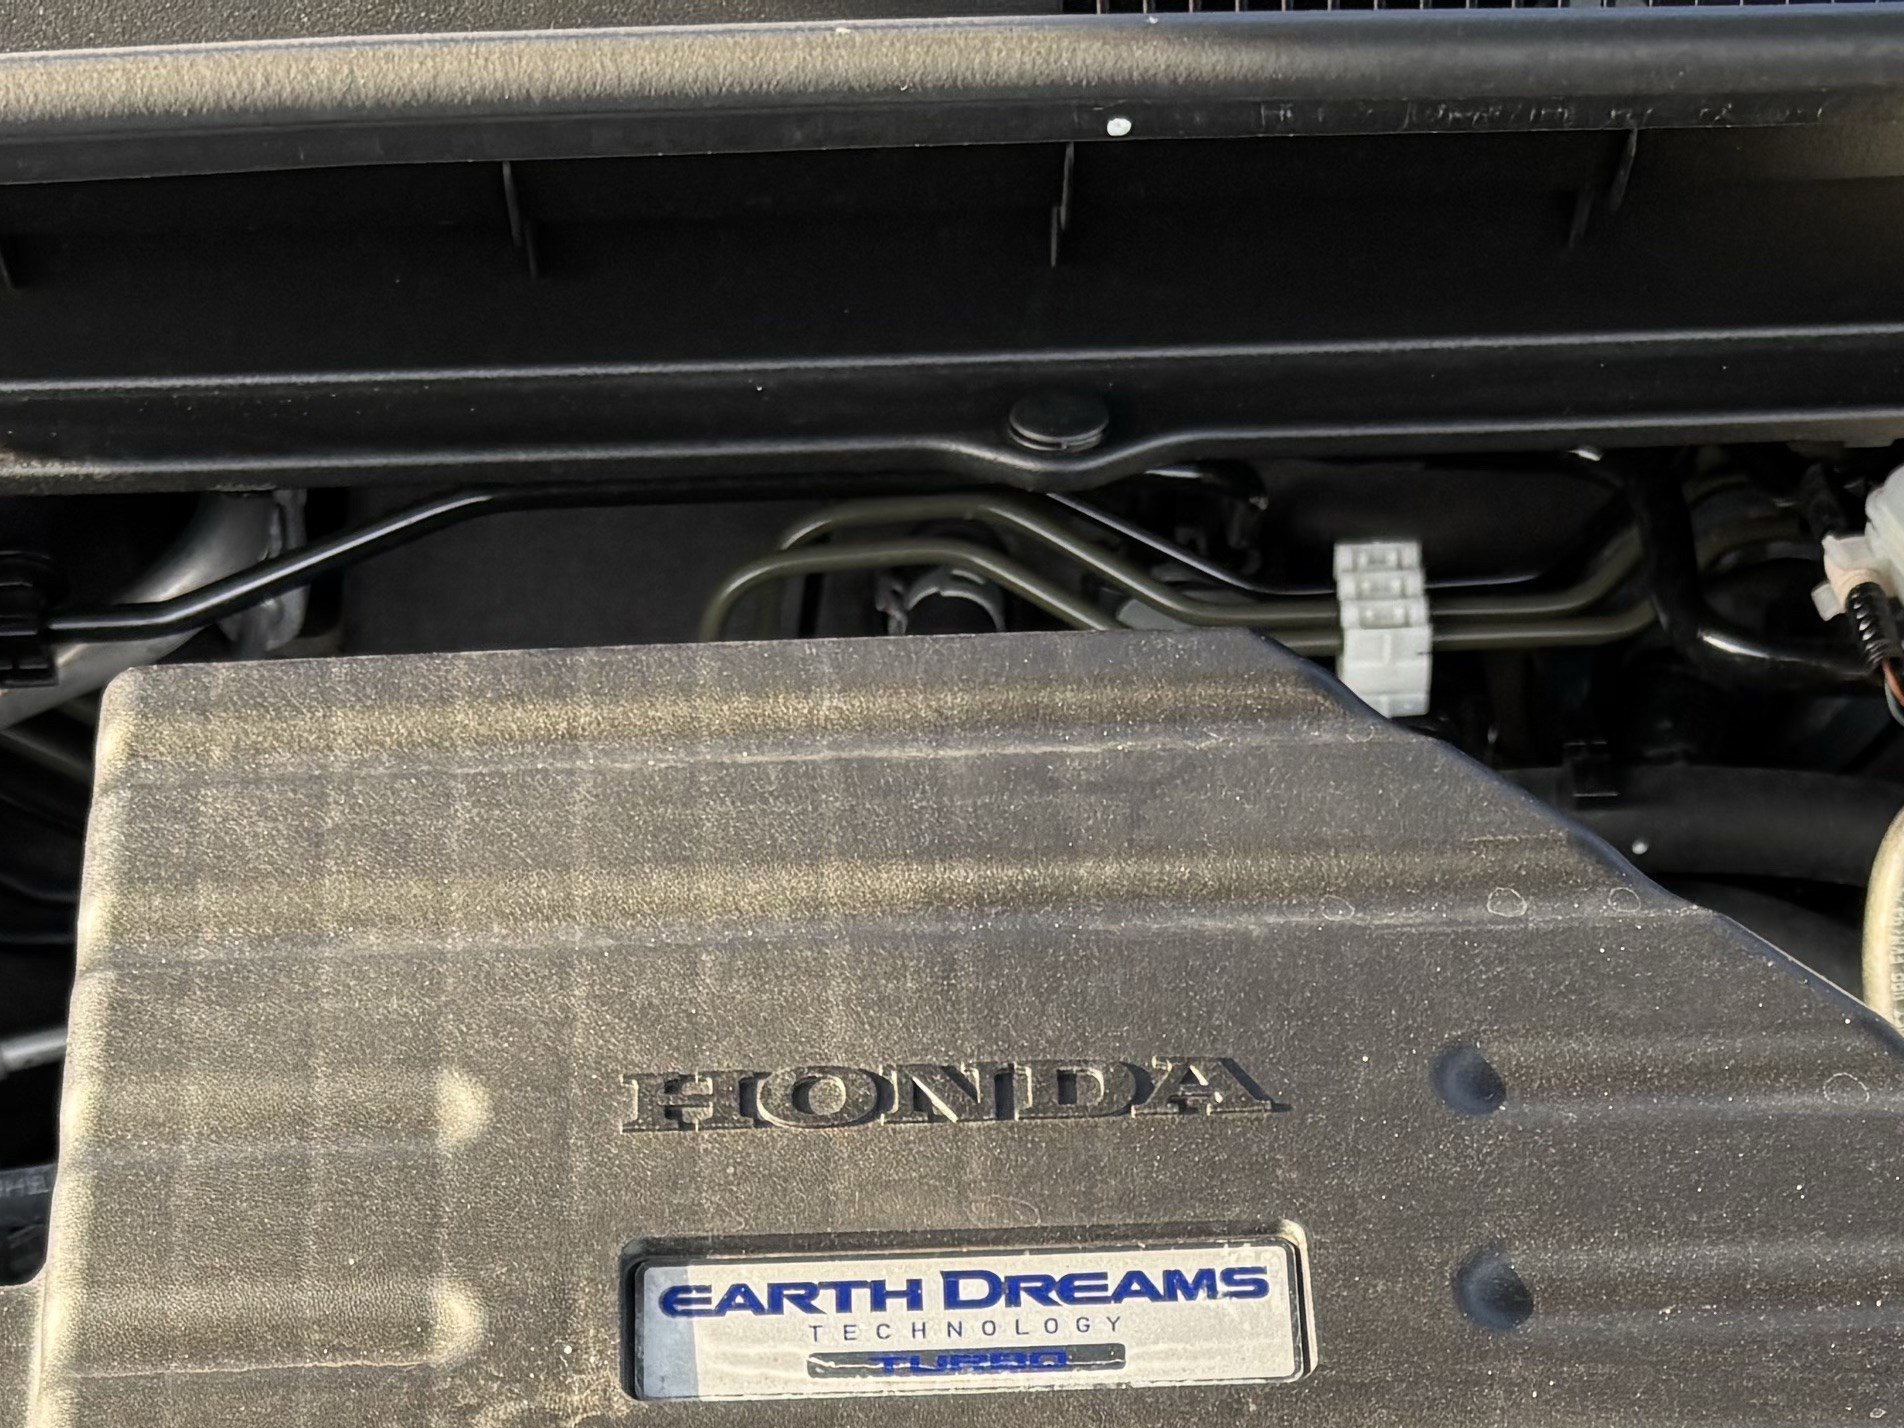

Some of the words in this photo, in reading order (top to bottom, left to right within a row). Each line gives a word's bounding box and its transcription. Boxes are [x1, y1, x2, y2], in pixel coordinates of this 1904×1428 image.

[619, 1055, 1291, 1134] HONDA
[658, 1276, 923, 1318] EARTH
[939, 1265, 1271, 1310] DREAMS
[808, 1315, 1123, 1342] TECHNOLOGY
[874, 1348, 1068, 1377] TURBO
